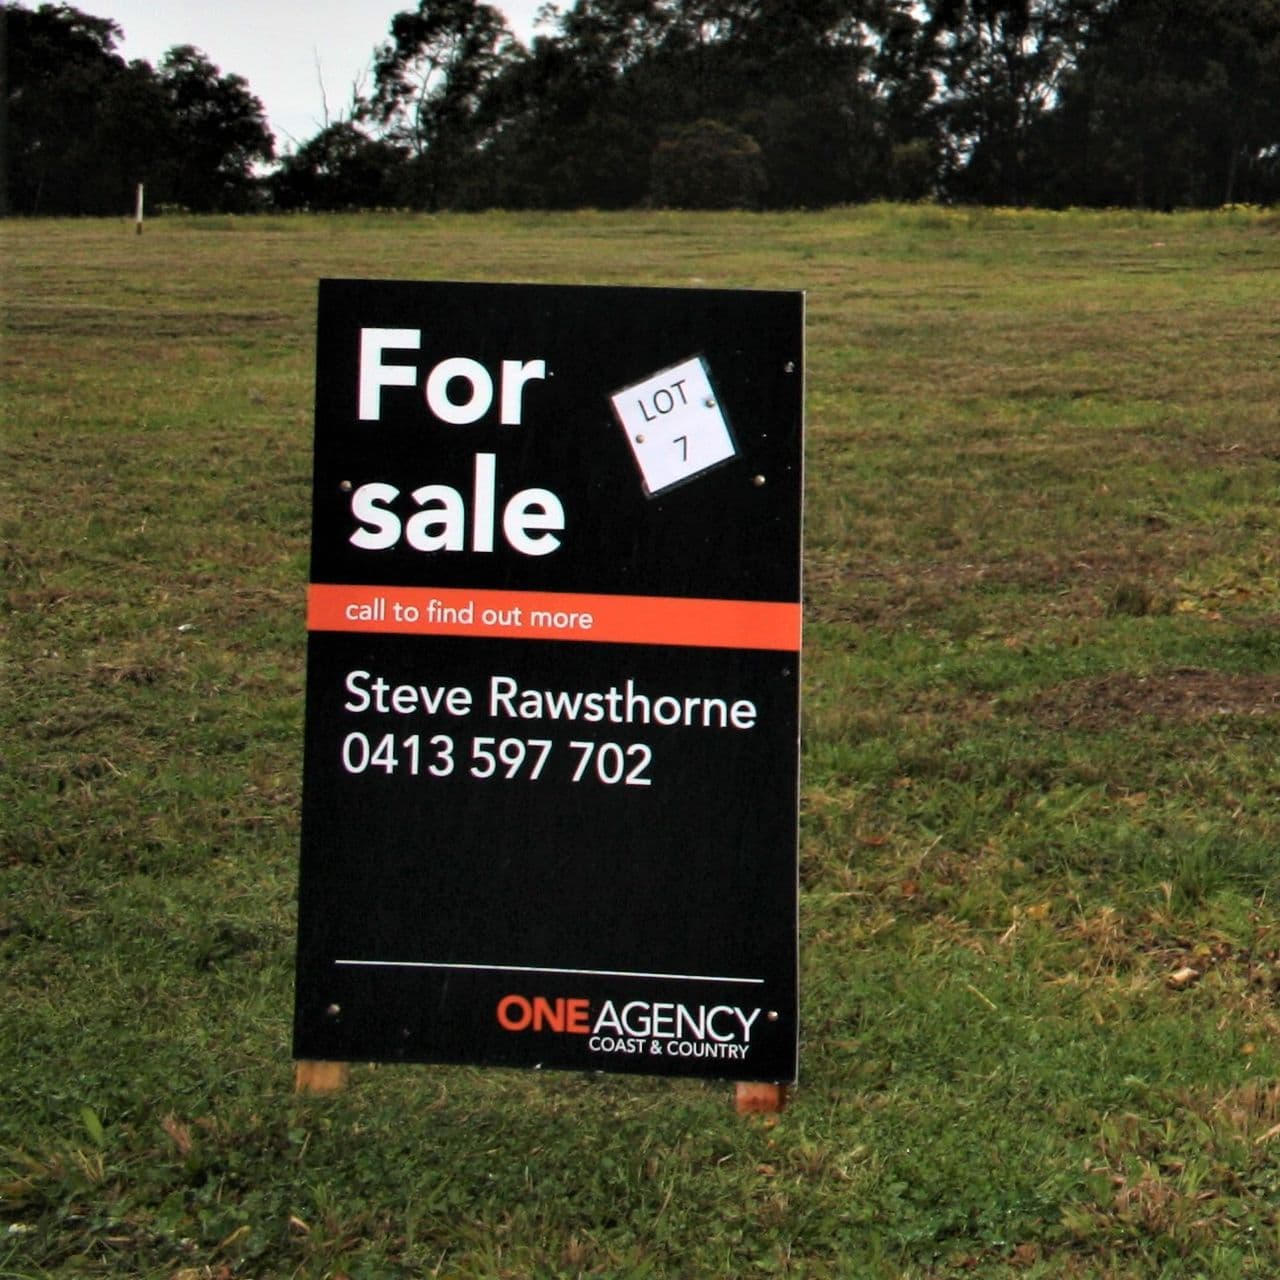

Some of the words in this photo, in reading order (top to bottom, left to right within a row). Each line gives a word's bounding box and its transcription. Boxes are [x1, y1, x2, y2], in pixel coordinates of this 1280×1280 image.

[358, 328, 546, 425] For
[637, 379, 690, 423] LOT
[673, 436, 690, 463] 7
[349, 453, 566, 556] sale
[345, 597, 385, 622] call
[394, 604, 419, 623] to
[426, 599, 474, 625] find
[483, 607, 523, 627] out
[531, 611, 594, 630] more
[344, 670, 472, 715] Steve
[489, 677, 757, 729] Rawsthorne
[342, 732, 454, 776] 0413
[470, 737, 553, 780] 597
[569, 741, 652, 785] 702
[589, 1036, 645, 1055] COAST
[650, 1040, 663, 1055] &
[667, 1041, 750, 1060] COUNTRY
